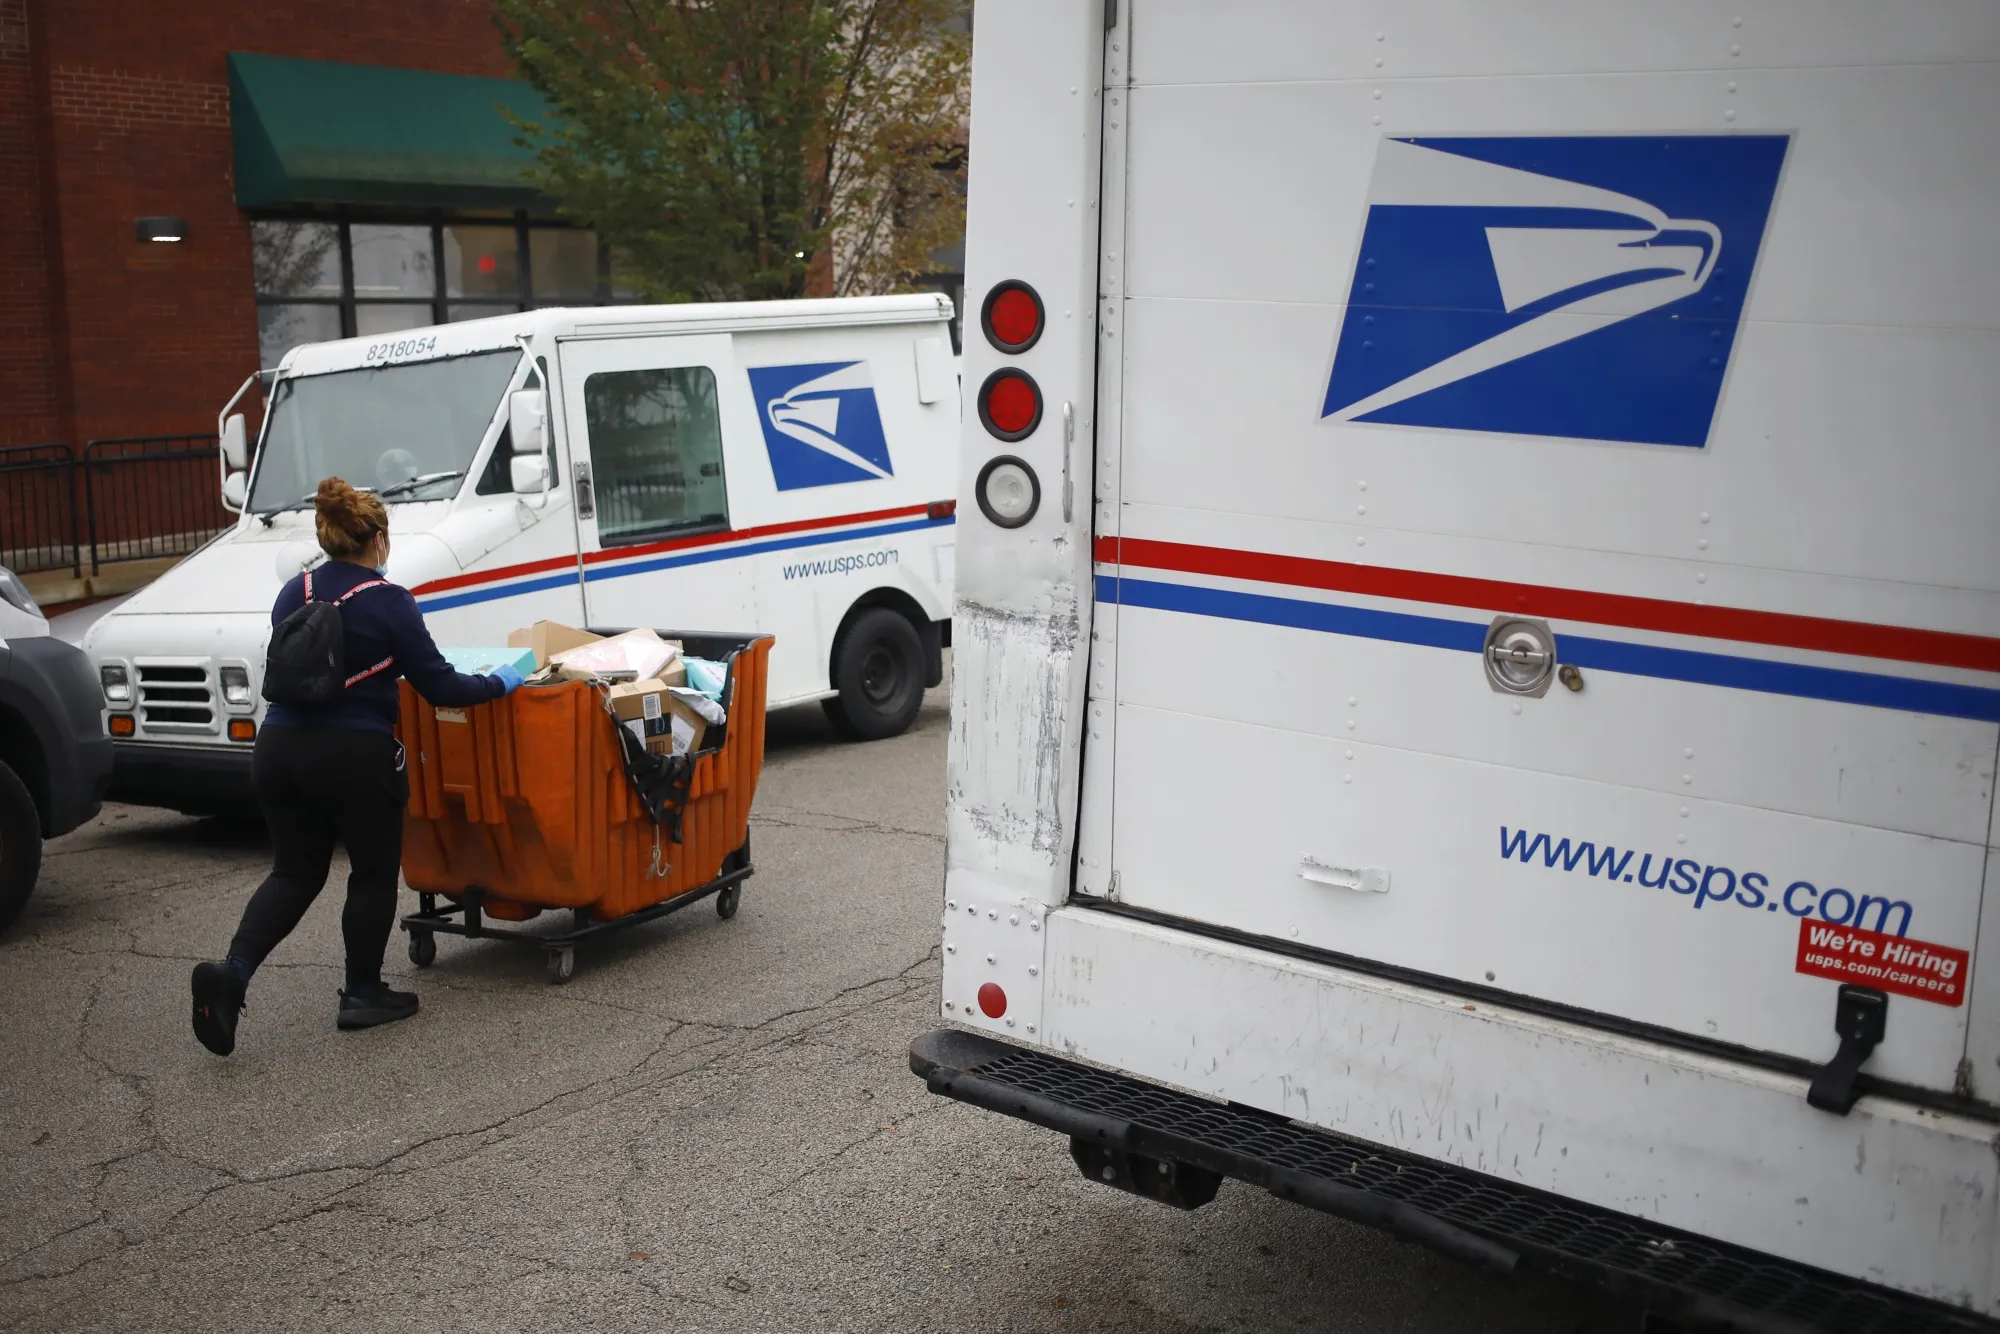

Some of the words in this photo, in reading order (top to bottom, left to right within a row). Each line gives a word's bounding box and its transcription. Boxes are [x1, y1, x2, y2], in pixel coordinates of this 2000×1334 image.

[367, 336, 437, 360] 8218054
[783, 550, 898, 580] www.usps.com
[1500, 826, 1914, 938] www.usps.com
[1809, 926, 1875, 957] We're
[1881, 941, 1958, 979] Hiring
[1805, 953, 1956, 994] usps.com/careers
